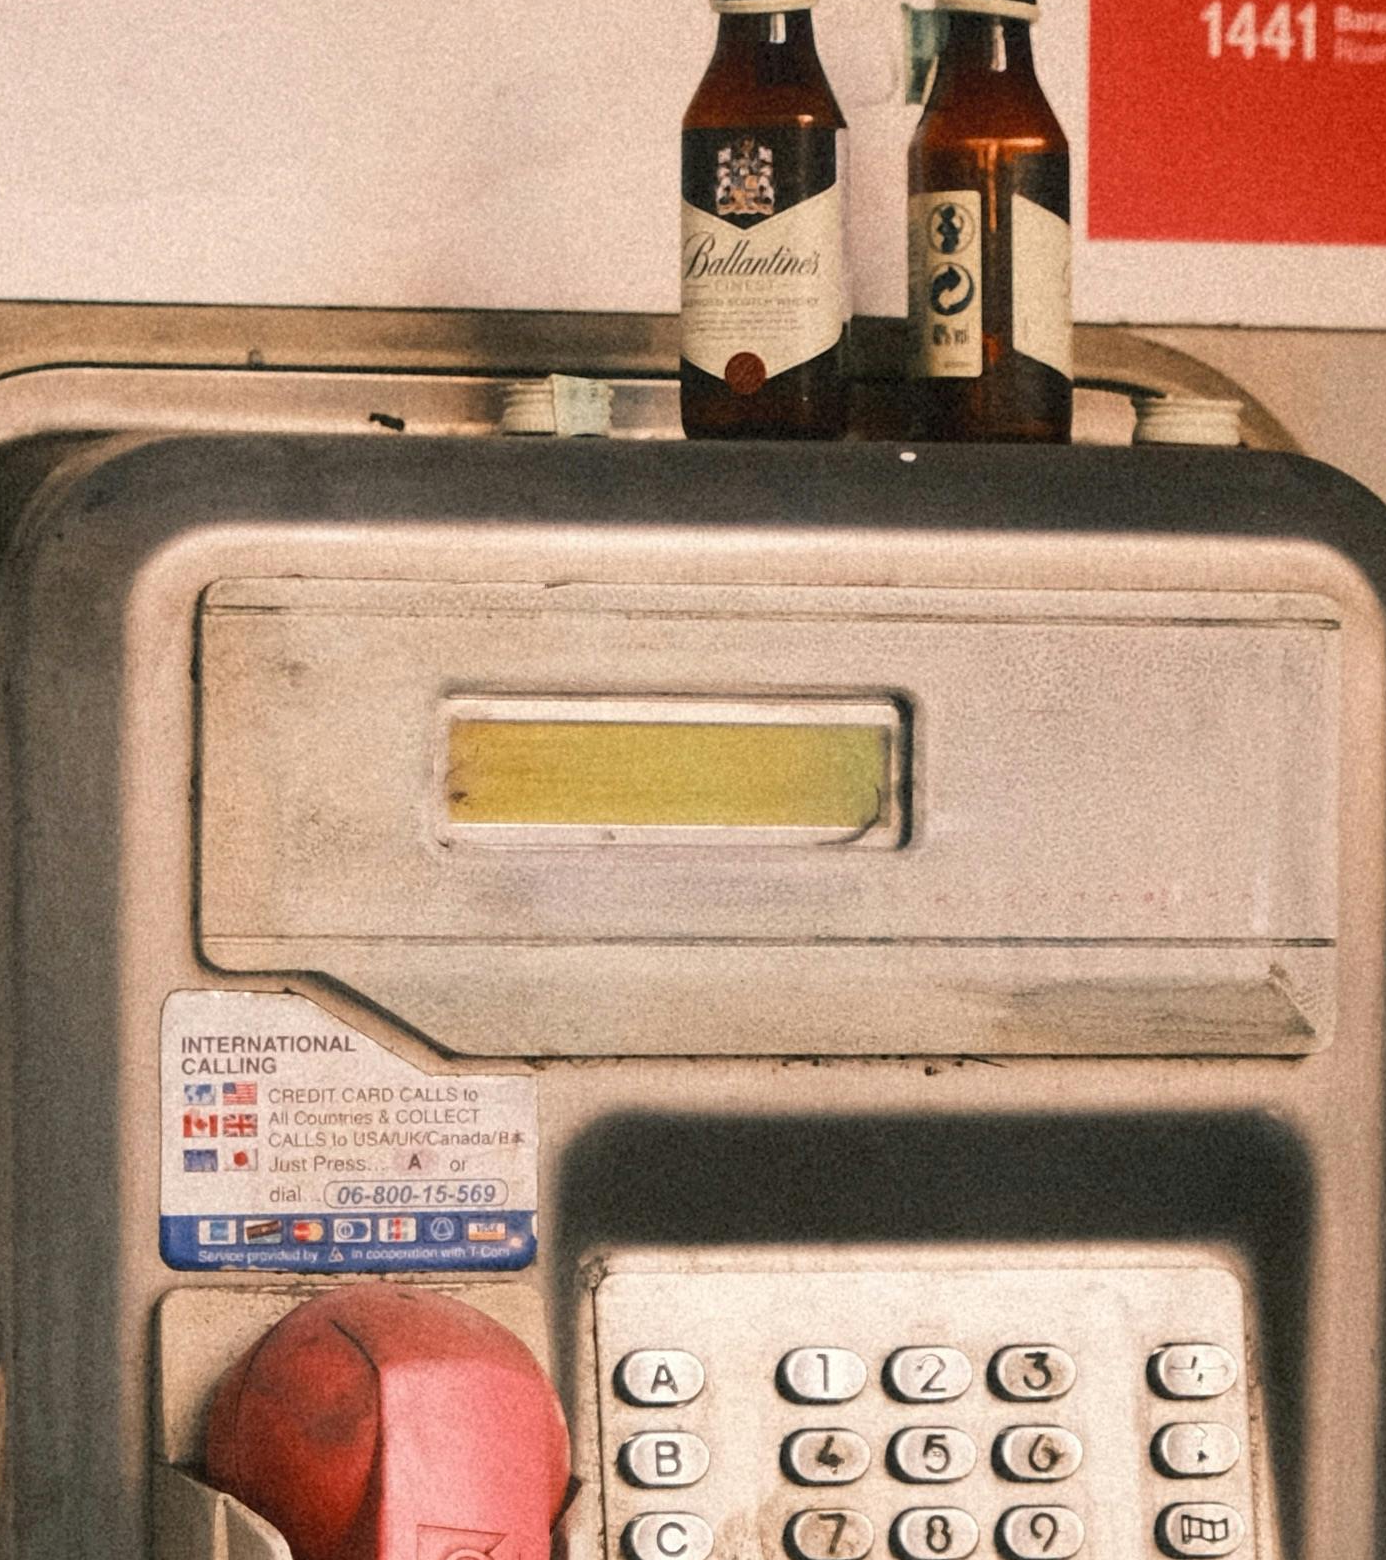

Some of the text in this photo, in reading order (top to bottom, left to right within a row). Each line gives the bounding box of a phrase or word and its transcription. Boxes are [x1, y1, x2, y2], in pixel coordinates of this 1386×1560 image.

[1201, 0, 1318, 61] 1441
[683, 231, 820, 279] Ballantine's
[181, 1035, 357, 1054] INTERNATIONAL
[181, 1057, 277, 1075] CALLING
[269, 1088, 479, 1104] CREDIT CARD CALLS to
[269, 1109, 481, 1125] All Countries & COLLECT
[269, 1132, 327, 1148] CALLS
[333, 1132, 348, 1147] to
[269, 1155, 307, 1172] Just
[408, 1154, 422, 1170] A
[450, 1159, 466, 1172] or
[337, 1185, 496, 1205] 06-800-15-569
[198, 1244, 510, 1266] Service provided by in cooperation with T-Com
[650, 1351, 1053, 1393] A 1 2 3
[655, 1441, 683, 1477] B
[924, 1434, 950, 1474] 5
[1027, 1434, 1059, 1472] 6
[656, 1512, 1058, 1558] C 7 8 9
